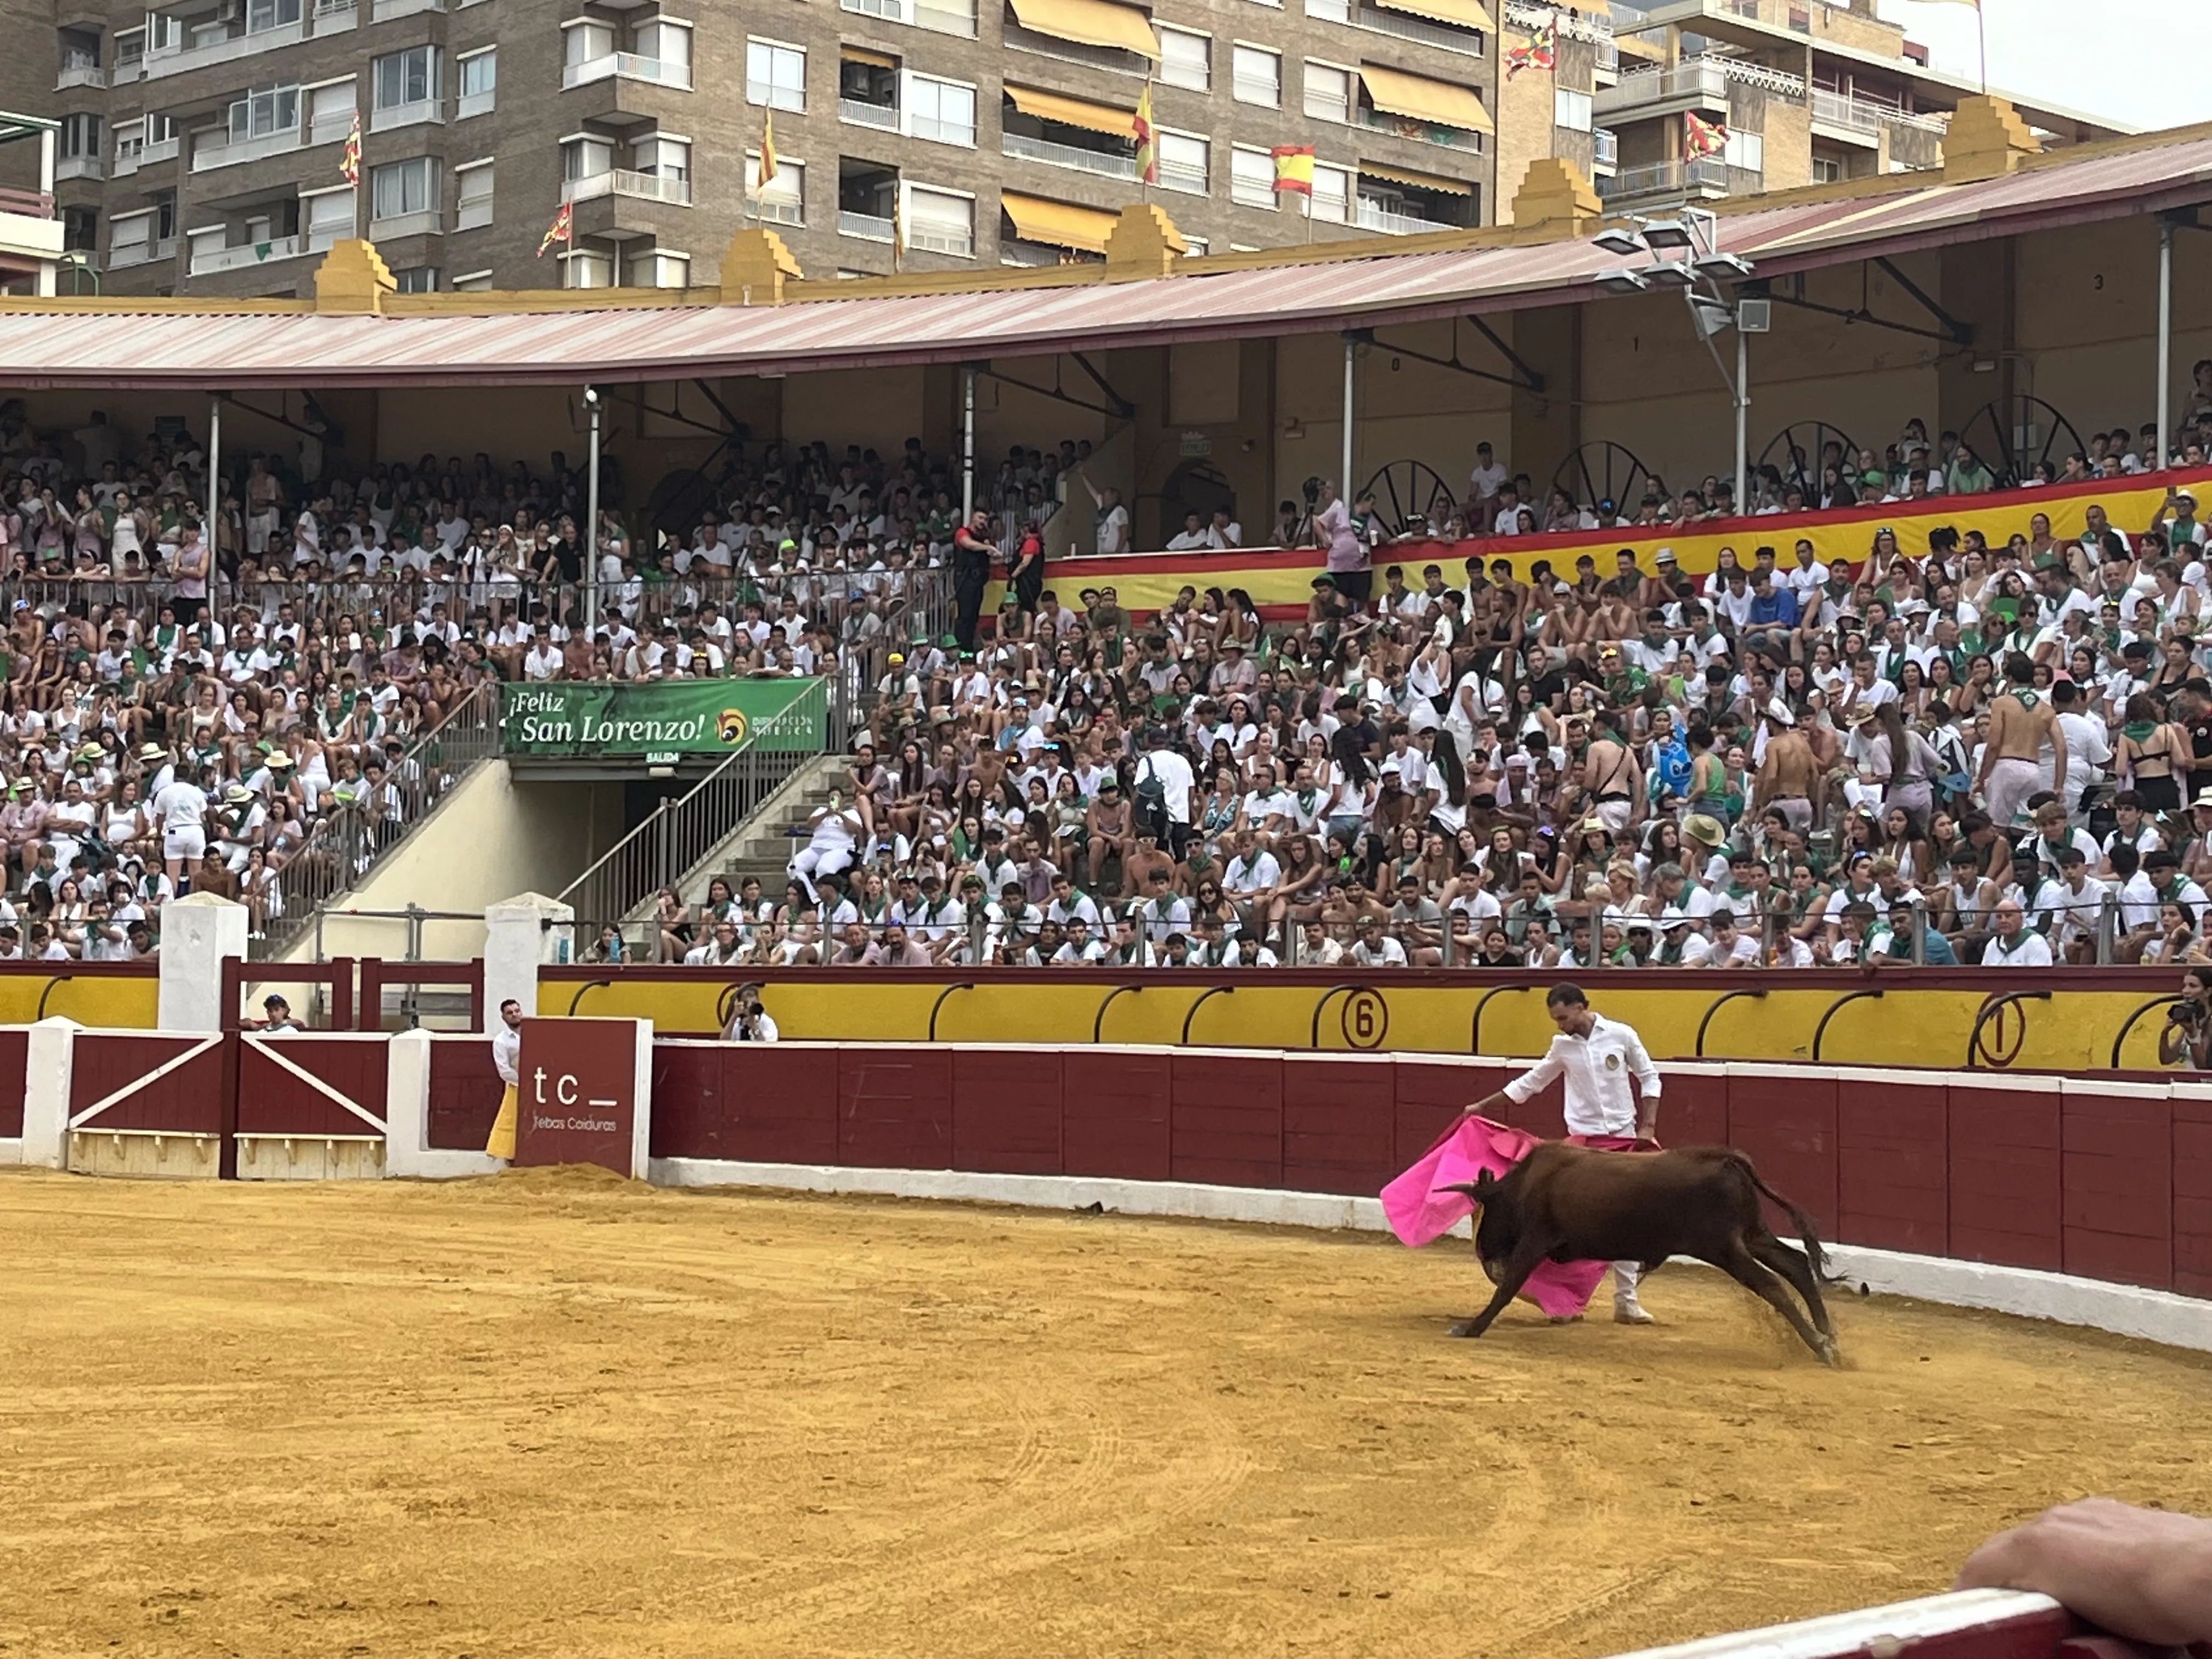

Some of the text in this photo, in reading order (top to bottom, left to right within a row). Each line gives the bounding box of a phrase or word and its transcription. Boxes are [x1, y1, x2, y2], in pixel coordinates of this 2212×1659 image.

[2094, 274, 2104, 290] 3
[510, 692, 565, 717] ¡Feliz
[522, 714, 706, 742] San Lorenzo!
[1356, 999, 1373, 1037] 6
[1990, 1005, 2004, 1053] 1
